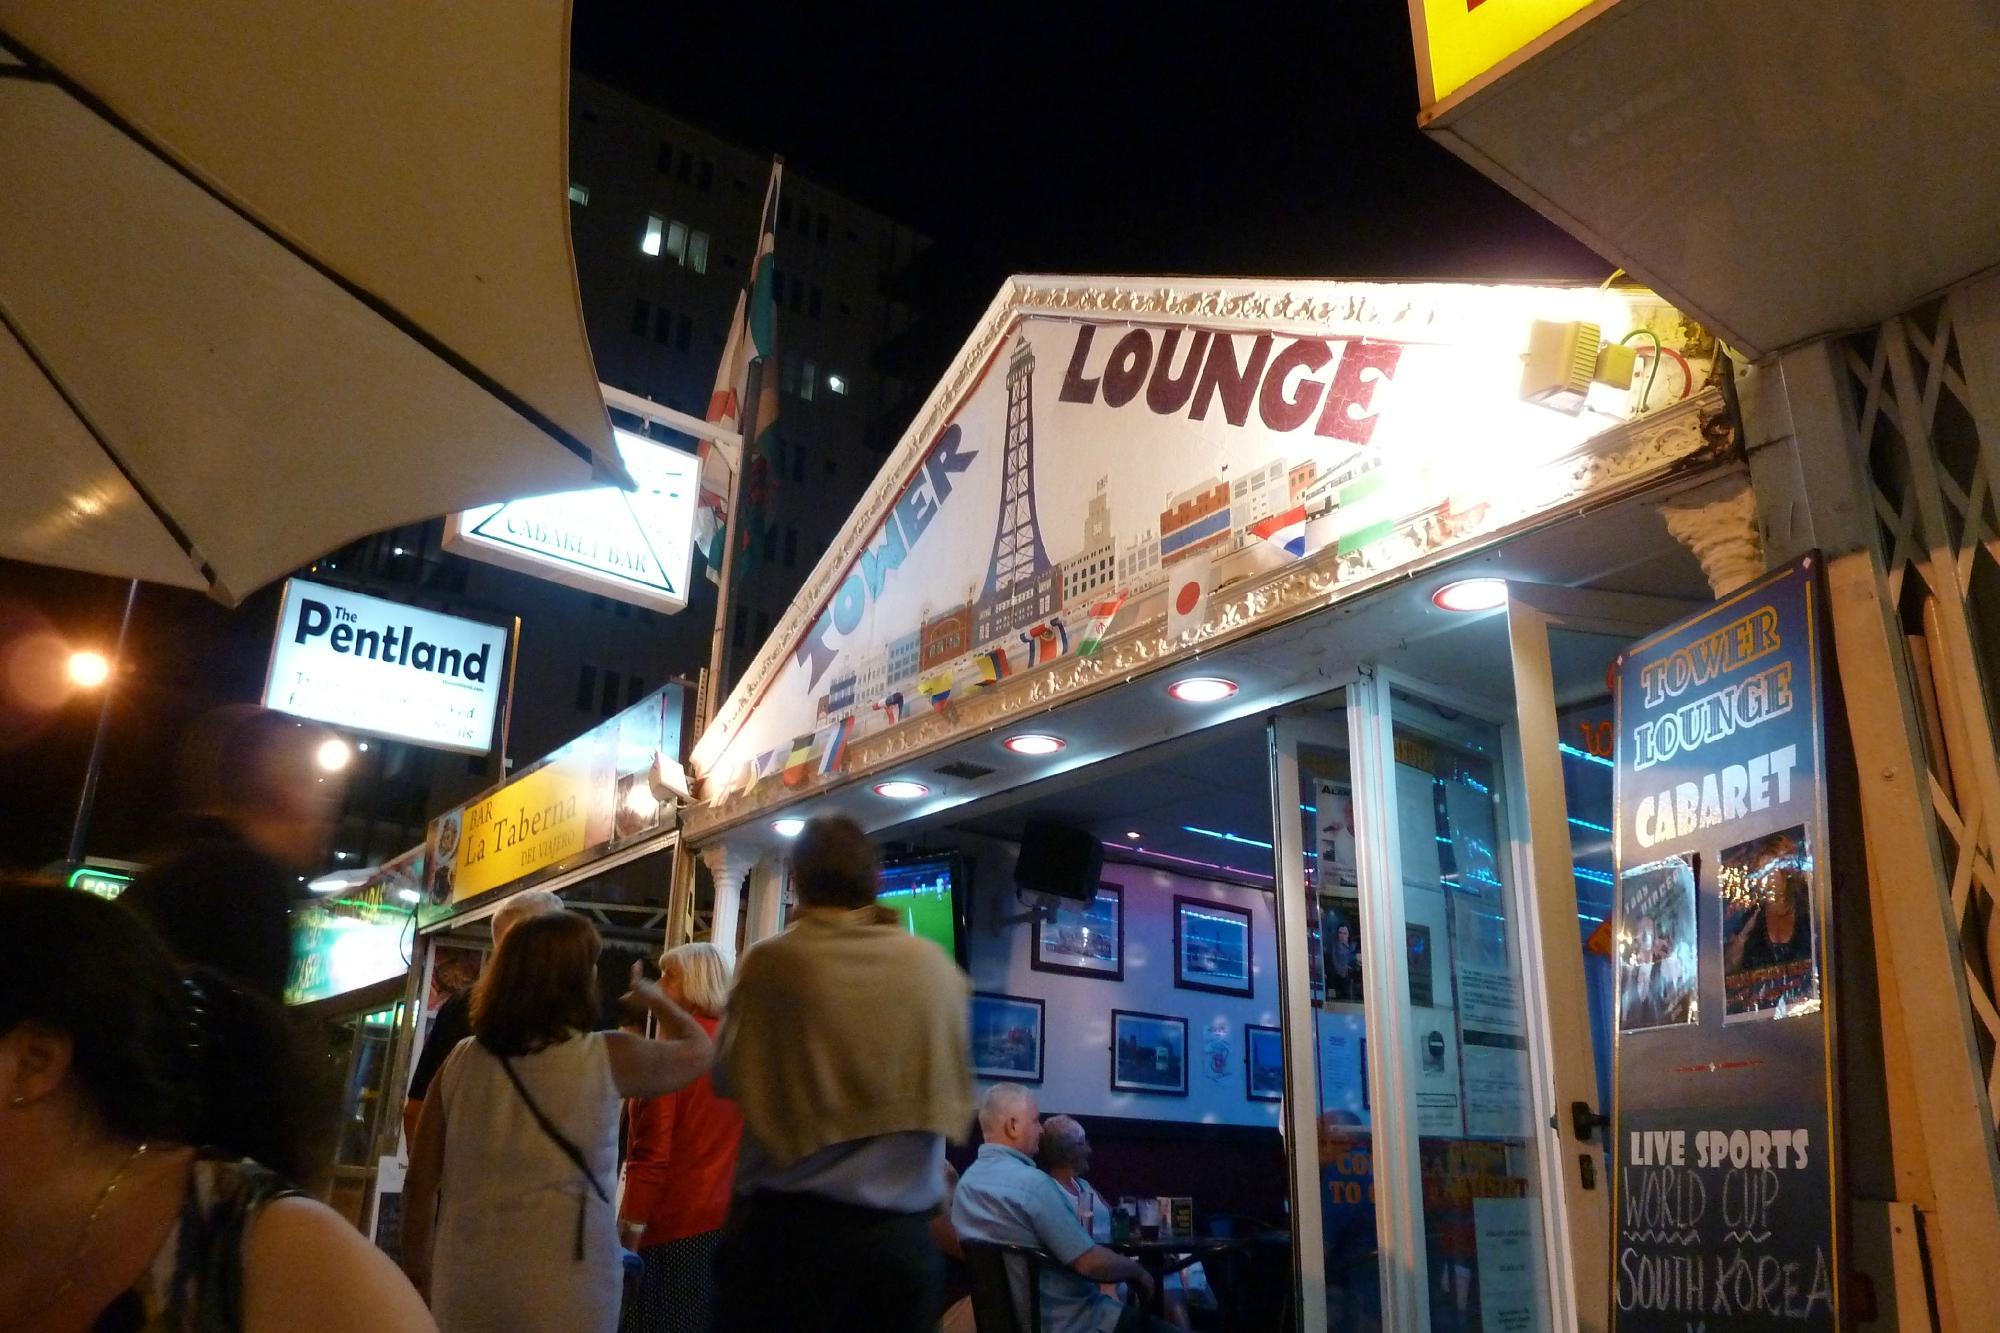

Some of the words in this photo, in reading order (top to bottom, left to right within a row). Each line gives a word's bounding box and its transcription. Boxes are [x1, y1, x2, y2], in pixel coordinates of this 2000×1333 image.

[1059, 323, 1405, 446] LOUNGE
[608, 545, 646, 574] BAR
[797, 423, 979, 693] TOWER
[295, 598, 491, 683] Pentland
[335, 606, 358, 623] The
[1640, 605, 1781, 709] TOWER
[1633, 661, 1793, 771] LOUNGE
[464, 835, 485, 867] La
[493, 794, 577, 853] Taberna
[470, 801, 494, 831] BAR
[1635, 744, 1796, 848] CABARET
[520, 849, 537, 867] DEL
[539, 831, 576, 861] VIAJERO
[1631, 1130, 1685, 1166] LIVE
[1695, 1129, 1809, 1169] SPORTS
[1624, 1165, 1706, 1228] WORLD
[1723, 1167, 1779, 1228] CUP
[1617, 1247, 1704, 1311] SOUTH
[1712, 1246, 1834, 1319] KOREA
